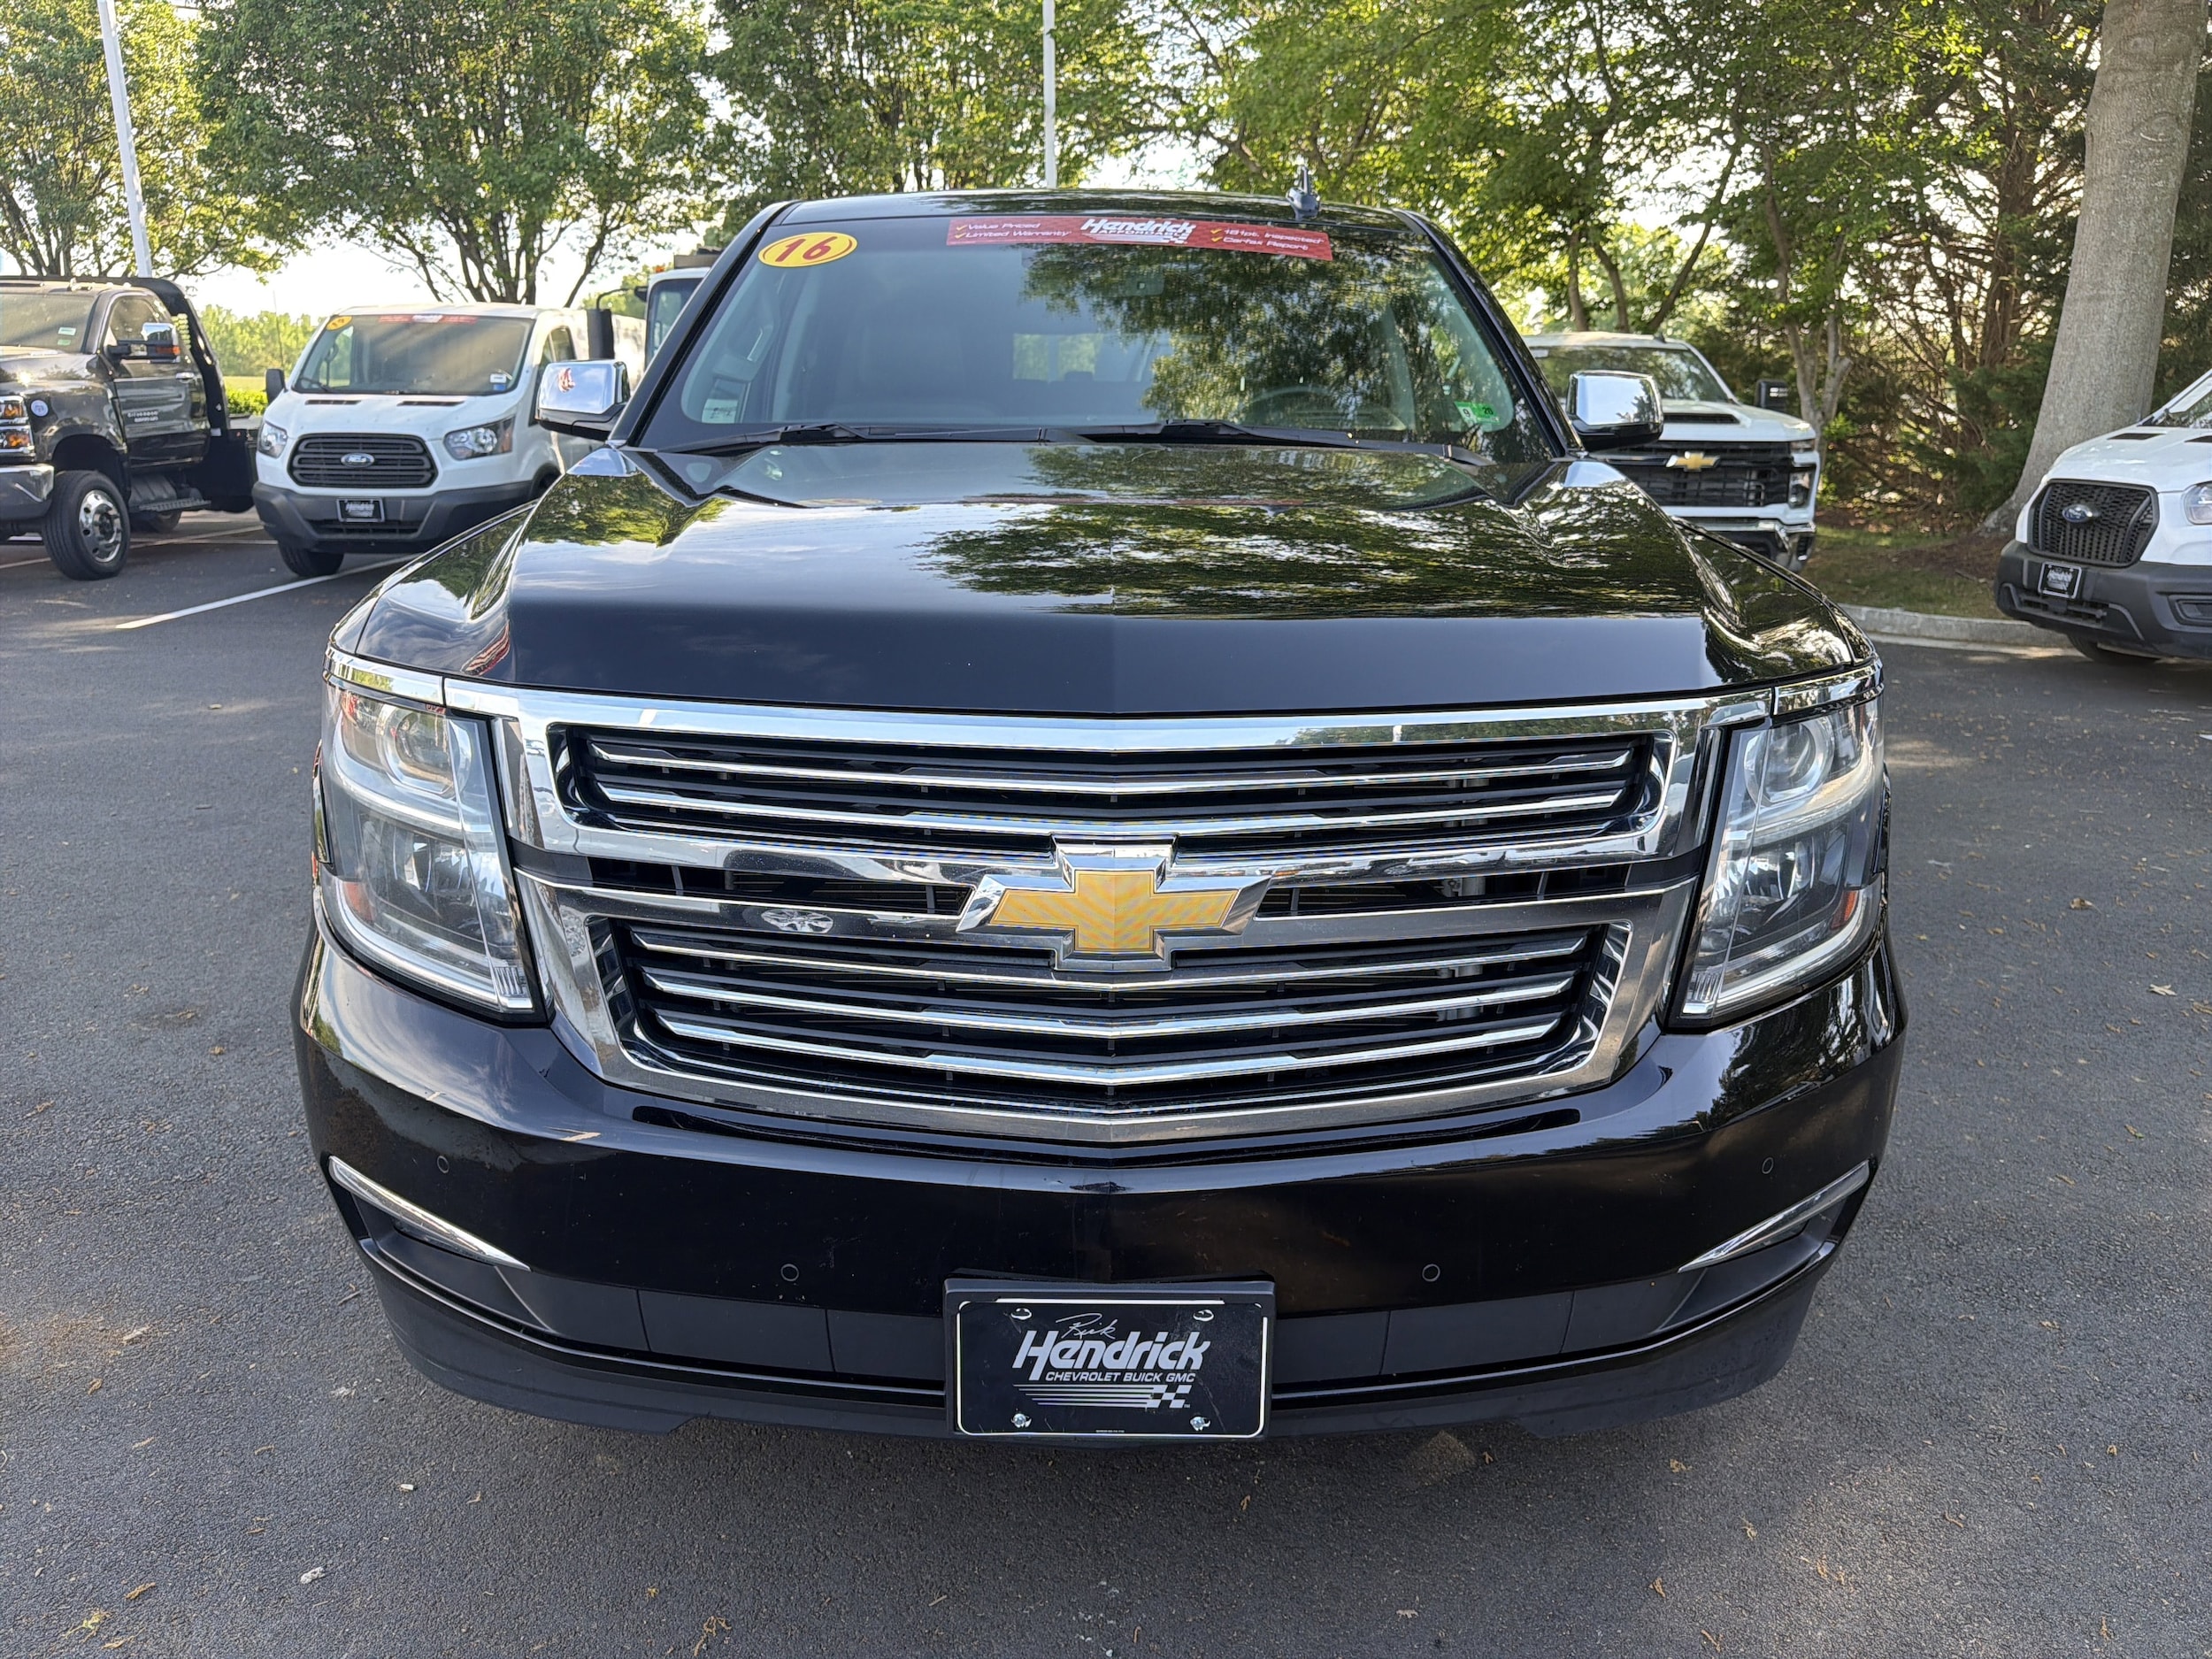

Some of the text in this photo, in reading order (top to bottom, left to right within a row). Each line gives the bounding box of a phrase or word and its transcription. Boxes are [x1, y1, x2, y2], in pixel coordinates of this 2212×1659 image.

[1080, 219, 1196, 234] Hendrick
[775, 235, 838, 263] 16
[1266, 241, 1309, 250] Report
[1011, 1330, 1211, 1381] Hendrick
[1045, 1371, 1196, 1382] CHEVROLET BUICK GMC
